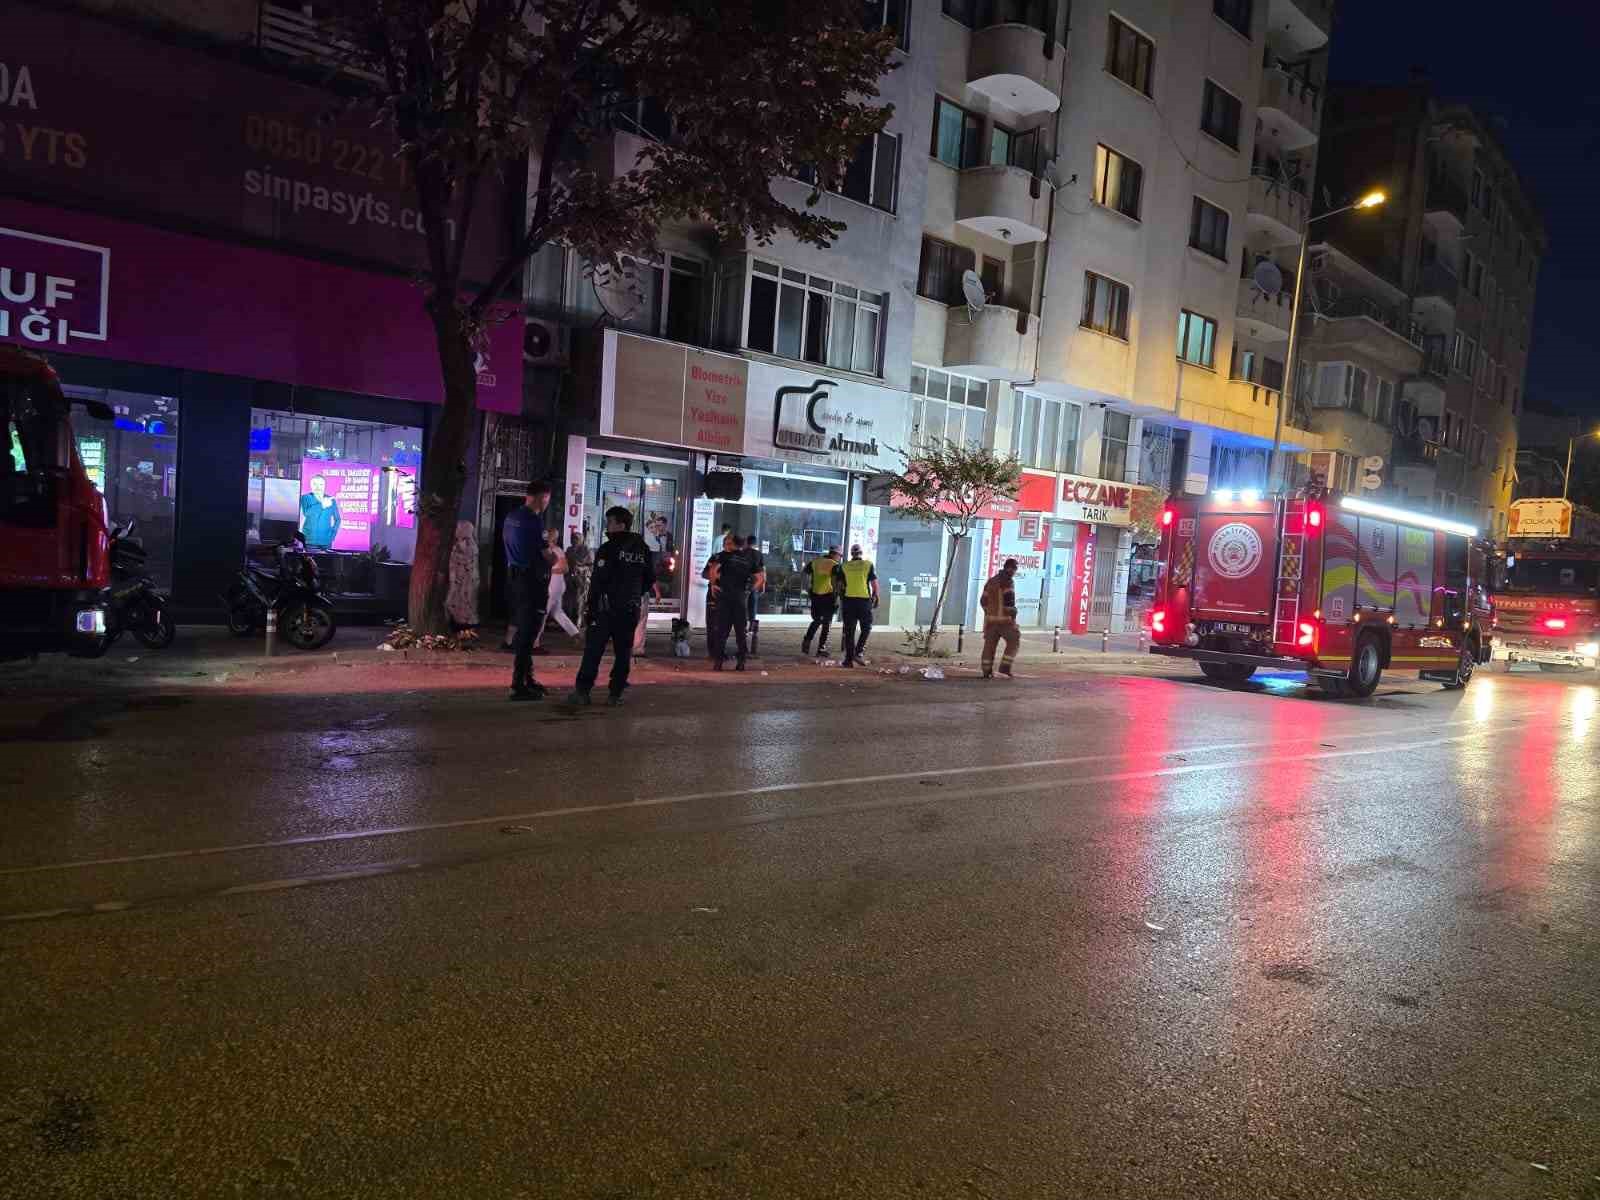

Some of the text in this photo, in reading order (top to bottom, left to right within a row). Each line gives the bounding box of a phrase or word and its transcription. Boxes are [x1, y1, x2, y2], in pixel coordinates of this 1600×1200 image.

[1062, 479, 1130, 509] ECZANE
[1082, 506, 1109, 522] TARIK
[1079, 543, 1095, 626] ECZANE
